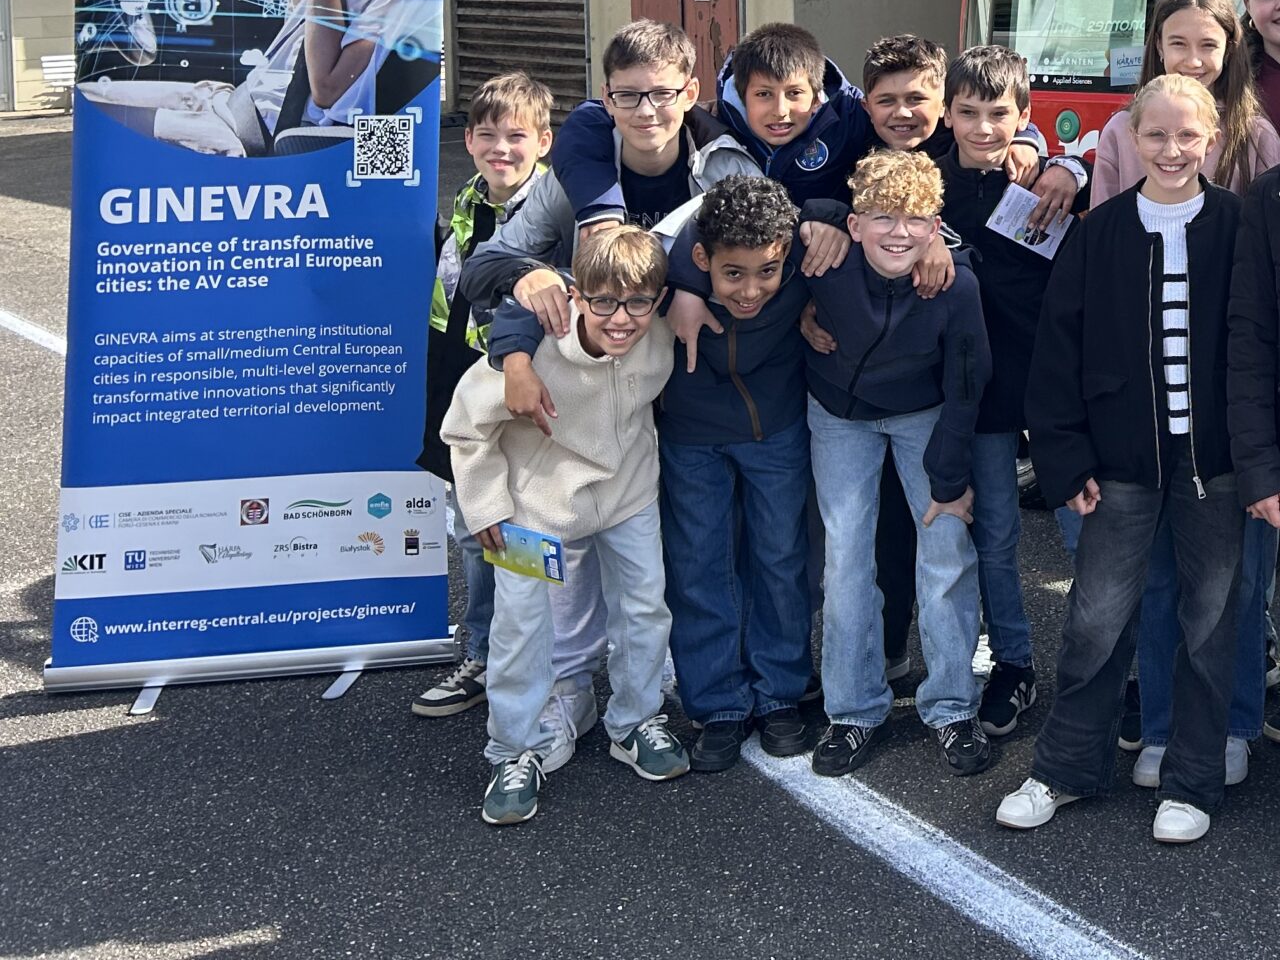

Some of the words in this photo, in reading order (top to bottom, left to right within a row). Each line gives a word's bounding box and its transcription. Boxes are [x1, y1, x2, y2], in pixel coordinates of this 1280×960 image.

[1053, 76, 1072, 85] Applied
[1073, 76, 1093, 85] Sciences
[100, 183, 329, 224] GINEVRA
[96, 239, 212, 256] Governance
[217, 237, 238, 252] of
[242, 234, 374, 252] transformative
[96, 257, 201, 274] innovation
[207, 257, 225, 271] in
[230, 253, 300, 271] Central
[305, 253, 382, 271] European
[96, 277, 152, 293] cities:
[157, 275, 190, 291] the
[195, 275, 222, 290] AV
[226, 274, 269, 288] case
[94, 332, 158, 346] GINEVRA
[161, 329, 196, 343] aims
[200, 330, 214, 342] at
[217, 324, 316, 342] strengthening
[319, 323, 392, 337] institutional
[94, 351, 164, 368] capacities
[167, 348, 184, 363] of
[186, 345, 289, 362] small/medium
[293, 342, 341, 357] Central
[344, 341, 403, 357] European
[93, 371, 130, 386] cities
[133, 370, 147, 383] in
[150, 365, 238, 386] responsible,
[242, 362, 315, 378] multi-level
[318, 362, 391, 377] governance
[394, 361, 407, 373] of
[93, 388, 199, 405] transformative
[203, 383, 286, 400] innovations
[289, 381, 318, 395] that
[321, 380, 396, 396] significantly
[92, 411, 141, 427] impact
[145, 405, 219, 424] integrated
[223, 402, 290, 418] territorial
[294, 399, 385, 416] development.
[405, 497, 431, 508] alda
[284, 512, 300, 520] BAD
[302, 509, 352, 519] SCHÖNBORN
[126, 552, 145, 563] TU
[273, 544, 290, 552] ZRS
[293, 543, 318, 551] Bistra
[74, 554, 107, 571] KIT
[104, 601, 416, 635] www.interreg-central.eu/projects/ginevra/
